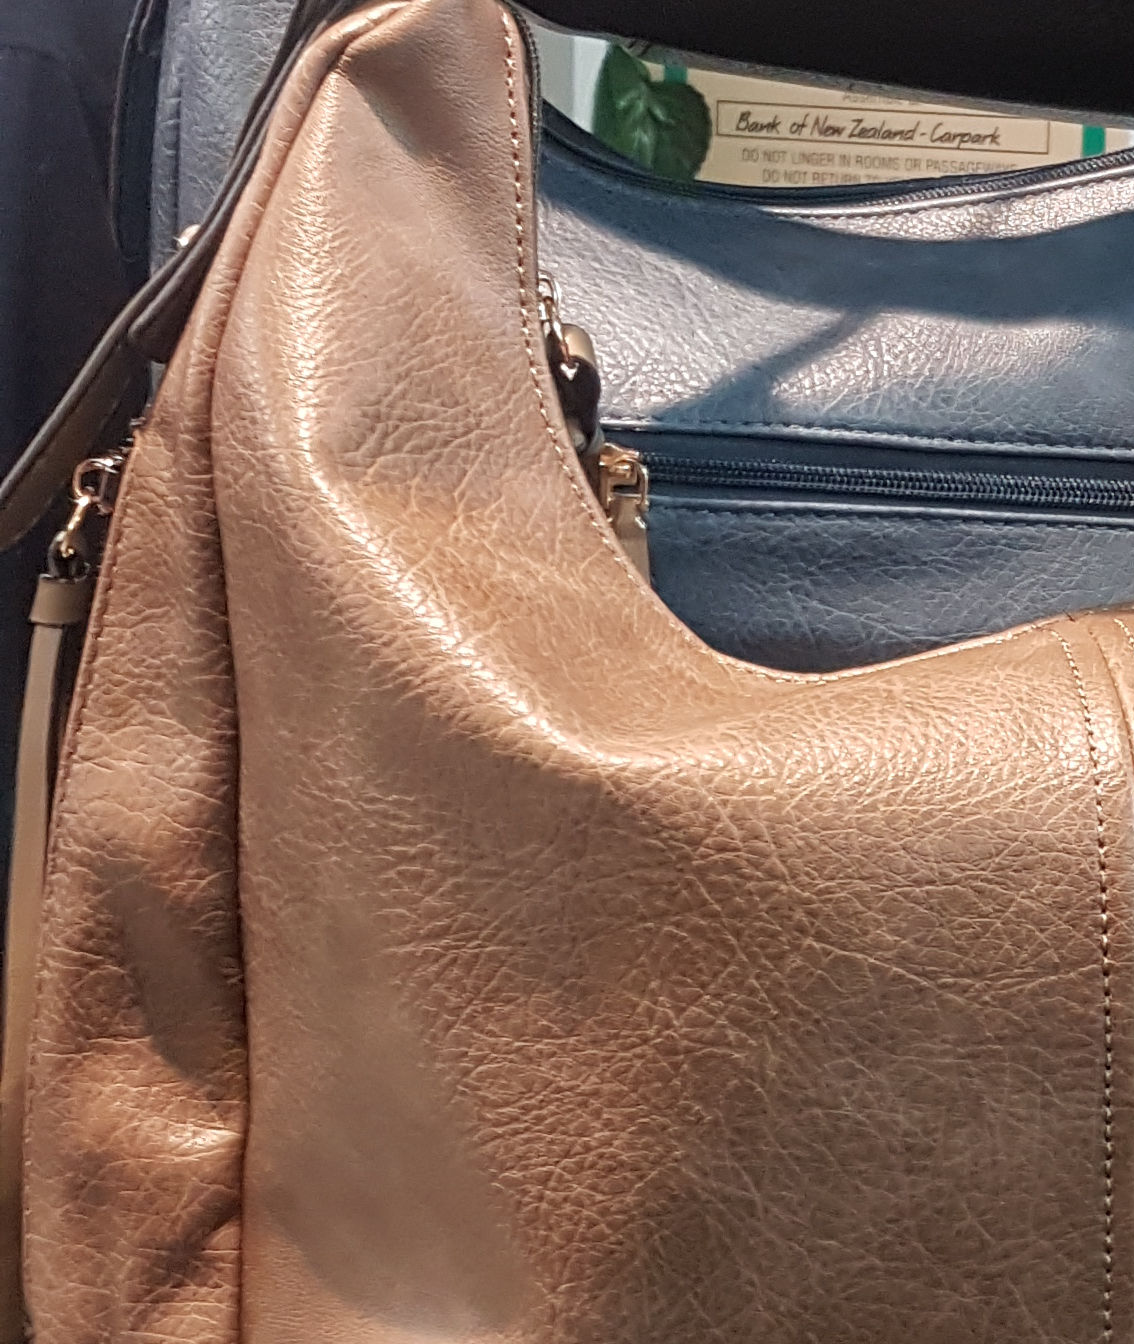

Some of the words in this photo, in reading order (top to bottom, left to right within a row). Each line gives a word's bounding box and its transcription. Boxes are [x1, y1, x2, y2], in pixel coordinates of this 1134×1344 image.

[735, 110, 782, 134] Bank
[789, 113, 810, 136] of
[810, 114, 846, 138] New
[742, 148, 759, 163] DO
[762, 150, 787, 164] NOT
[791, 151, 835, 167] LINGER
[839, 154, 851, 168] IN
[855, 155, 900, 170] ROOMS
[904, 158, 921, 172] OR
[762, 168, 780, 183] DO
[783, 170, 807, 185] NOT
